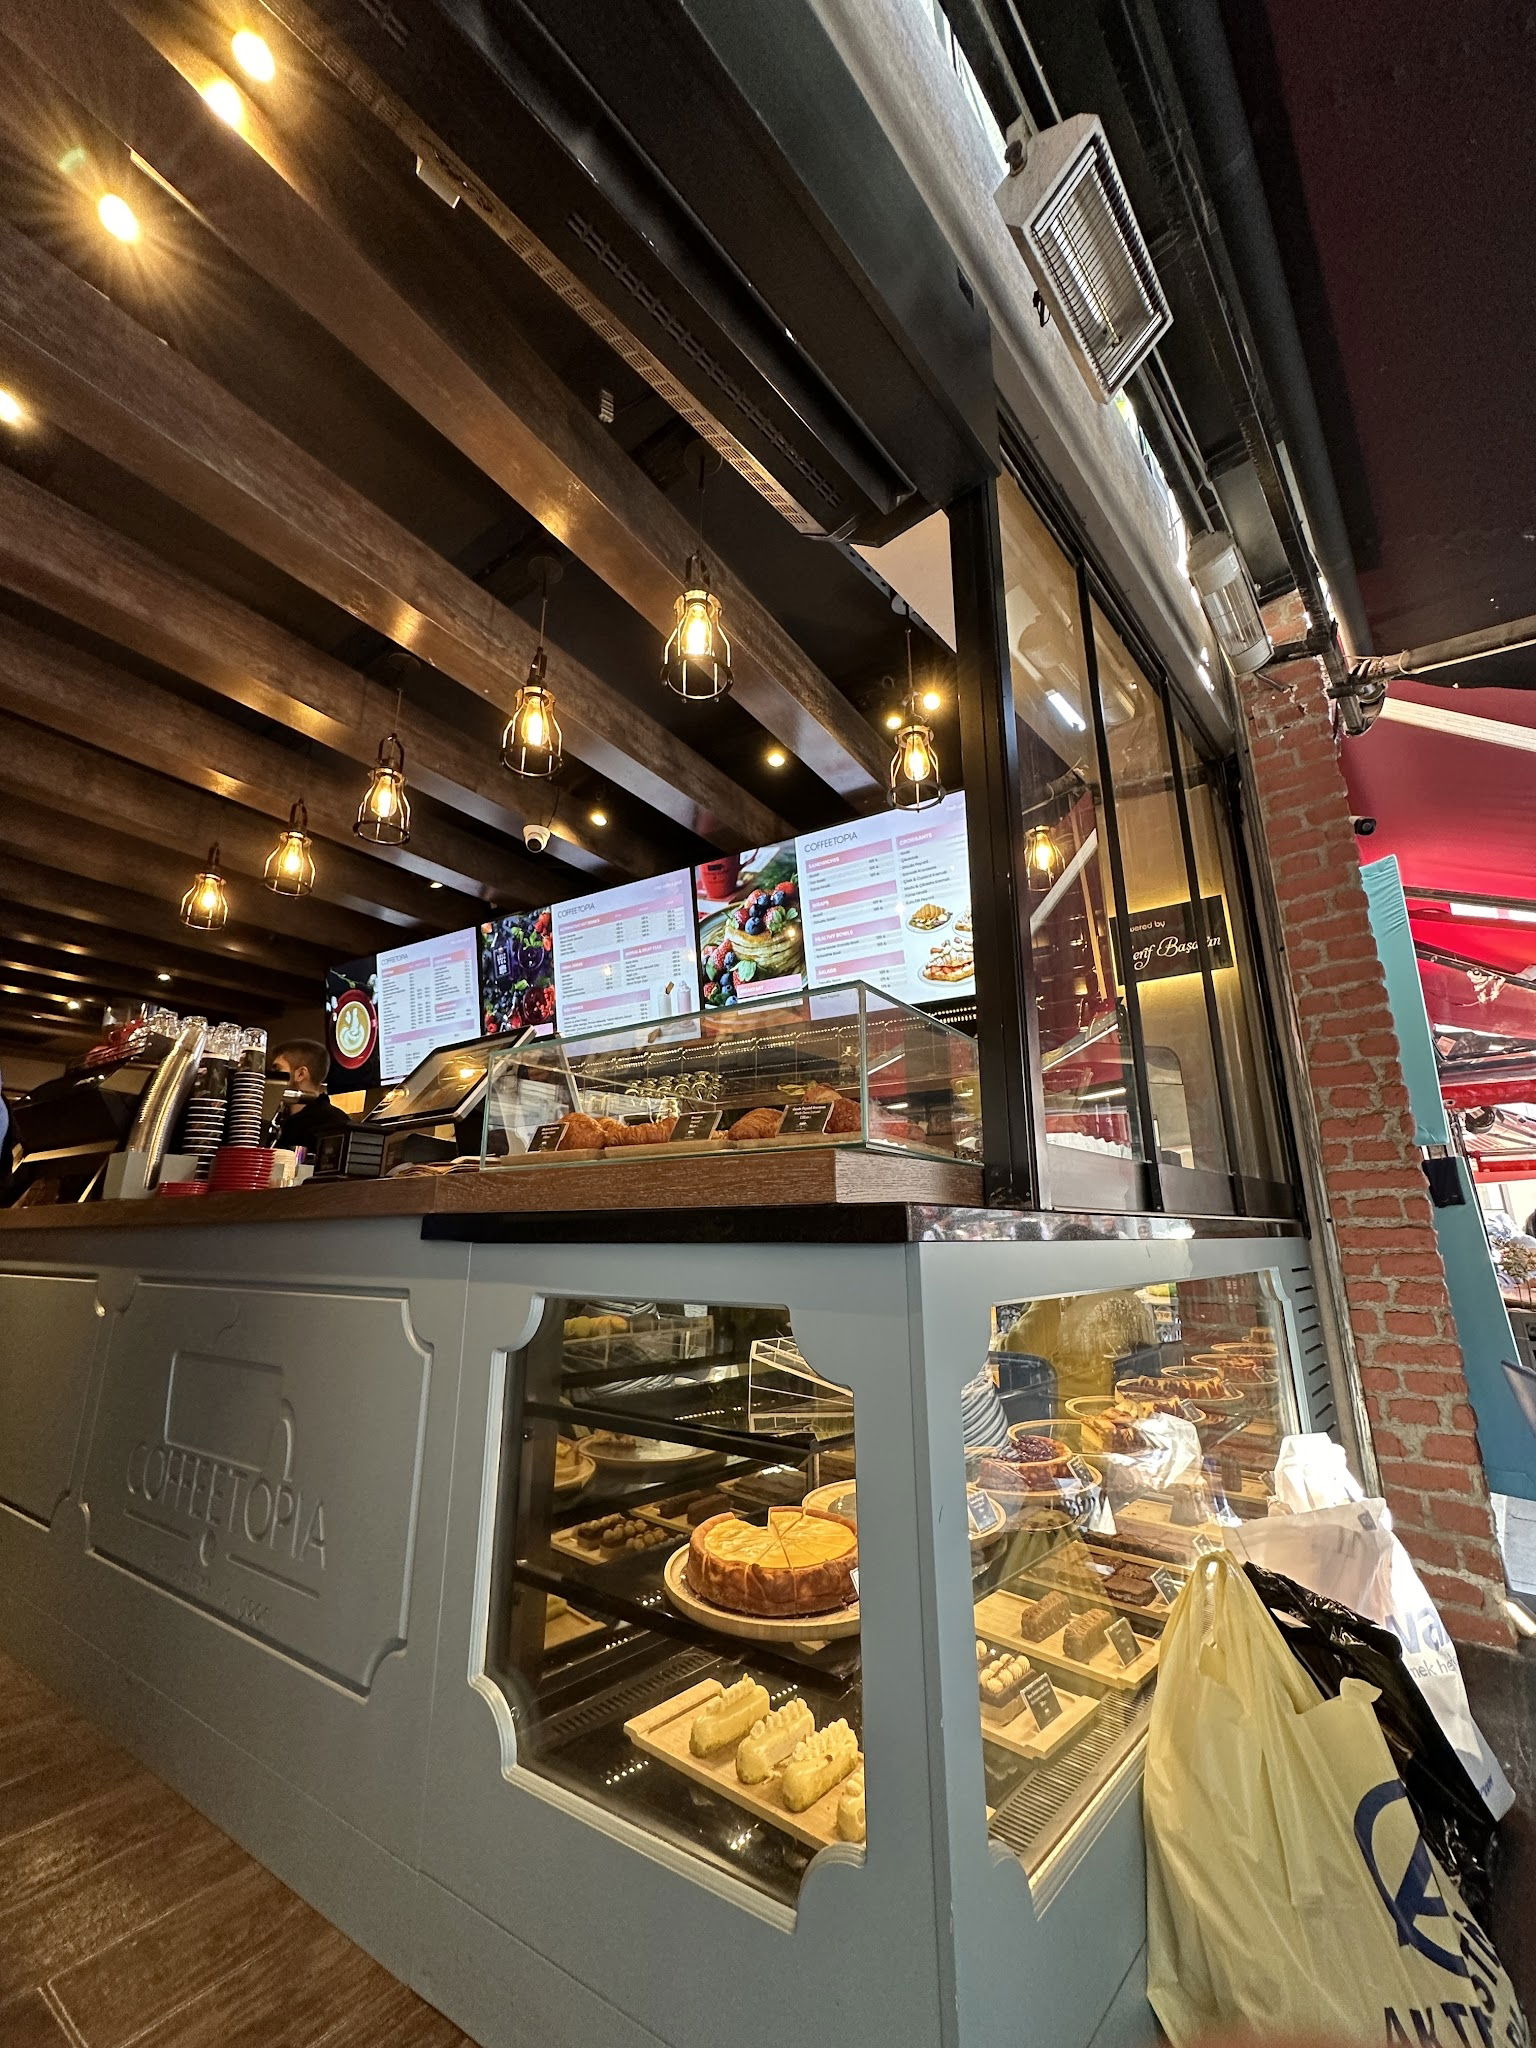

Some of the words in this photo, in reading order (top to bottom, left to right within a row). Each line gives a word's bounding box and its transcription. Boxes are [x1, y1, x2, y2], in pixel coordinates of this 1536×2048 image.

[804, 831, 858, 853] COFFEETOPIA
[557, 902, 596, 919] COFFEETOPIA
[1154, 919, 1166, 929] by
[126, 1441, 326, 1571] COFFEETOPIA
